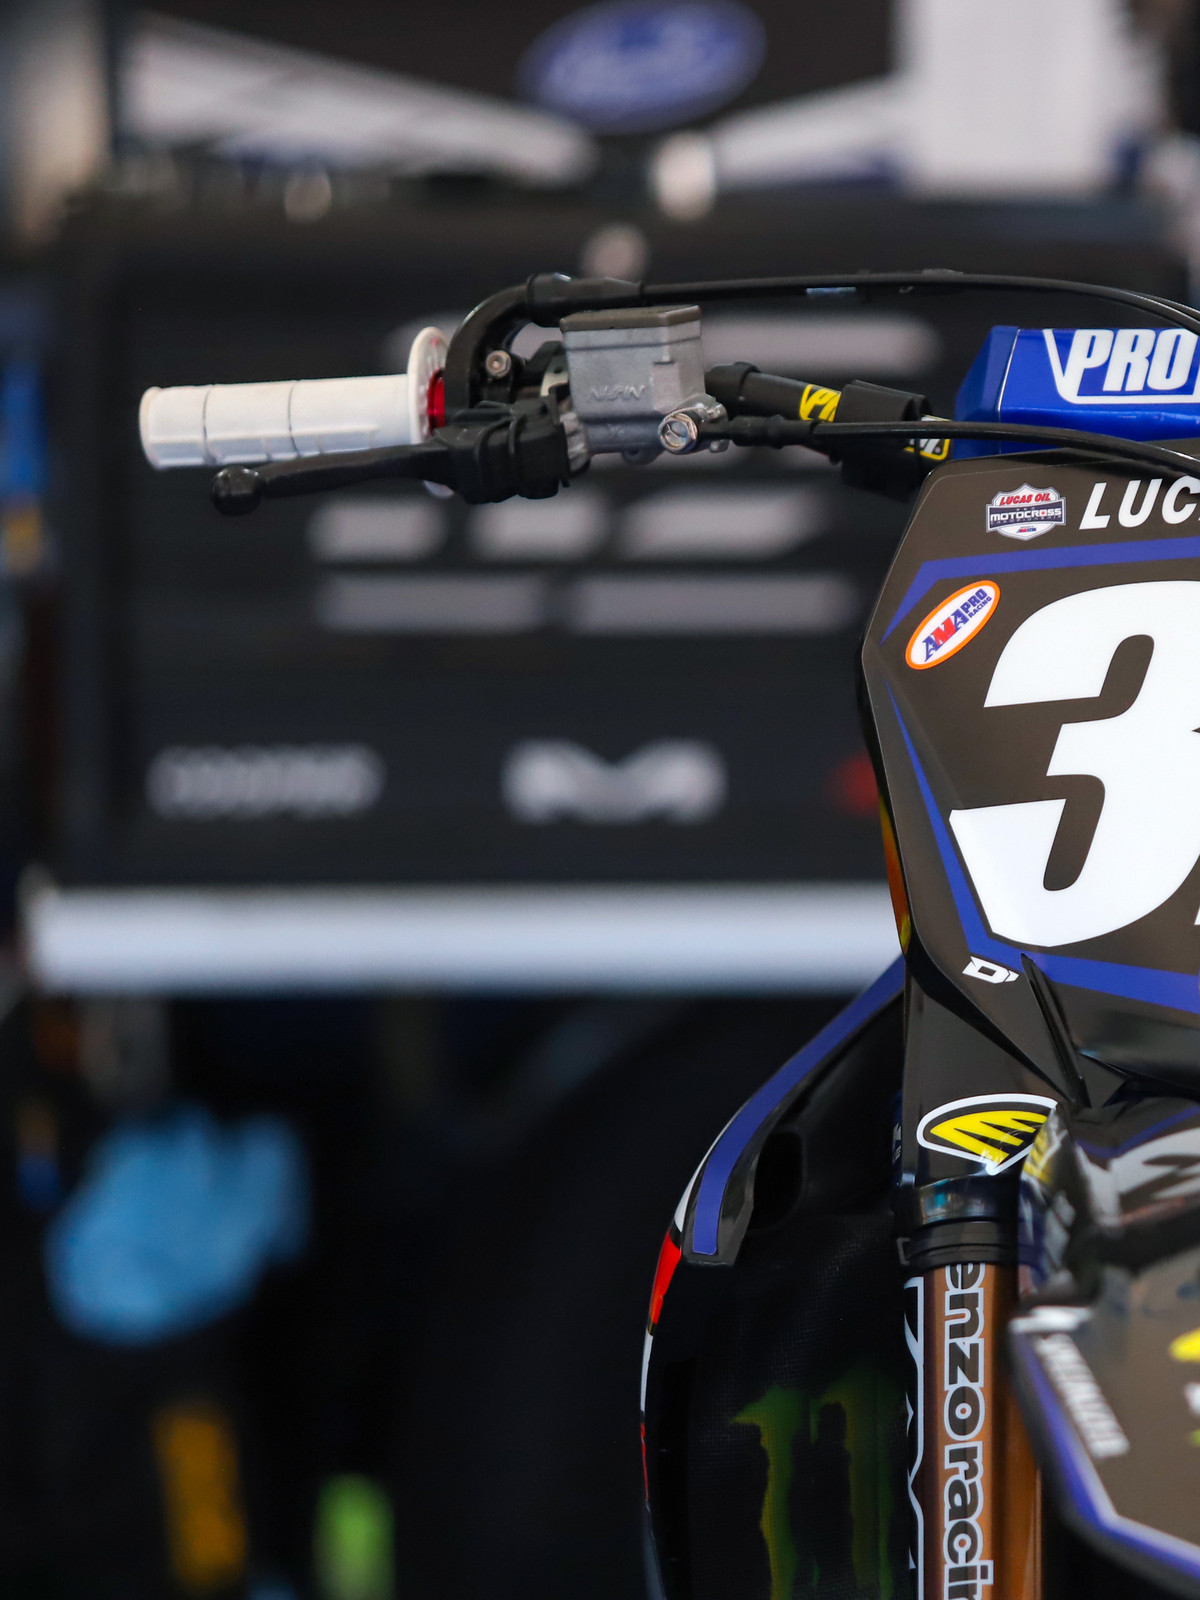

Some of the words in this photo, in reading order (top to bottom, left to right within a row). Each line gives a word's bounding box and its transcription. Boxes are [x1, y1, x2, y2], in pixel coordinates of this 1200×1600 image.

[1000, 494, 1033, 505] LUCAS
[1034, 492, 1051, 502] OIL
[990, 508, 1062, 522] MOTOCROSS
[960, 588, 988, 614] PRO
[967, 596, 992, 618] RACING
[922, 609, 970, 662] AMA
